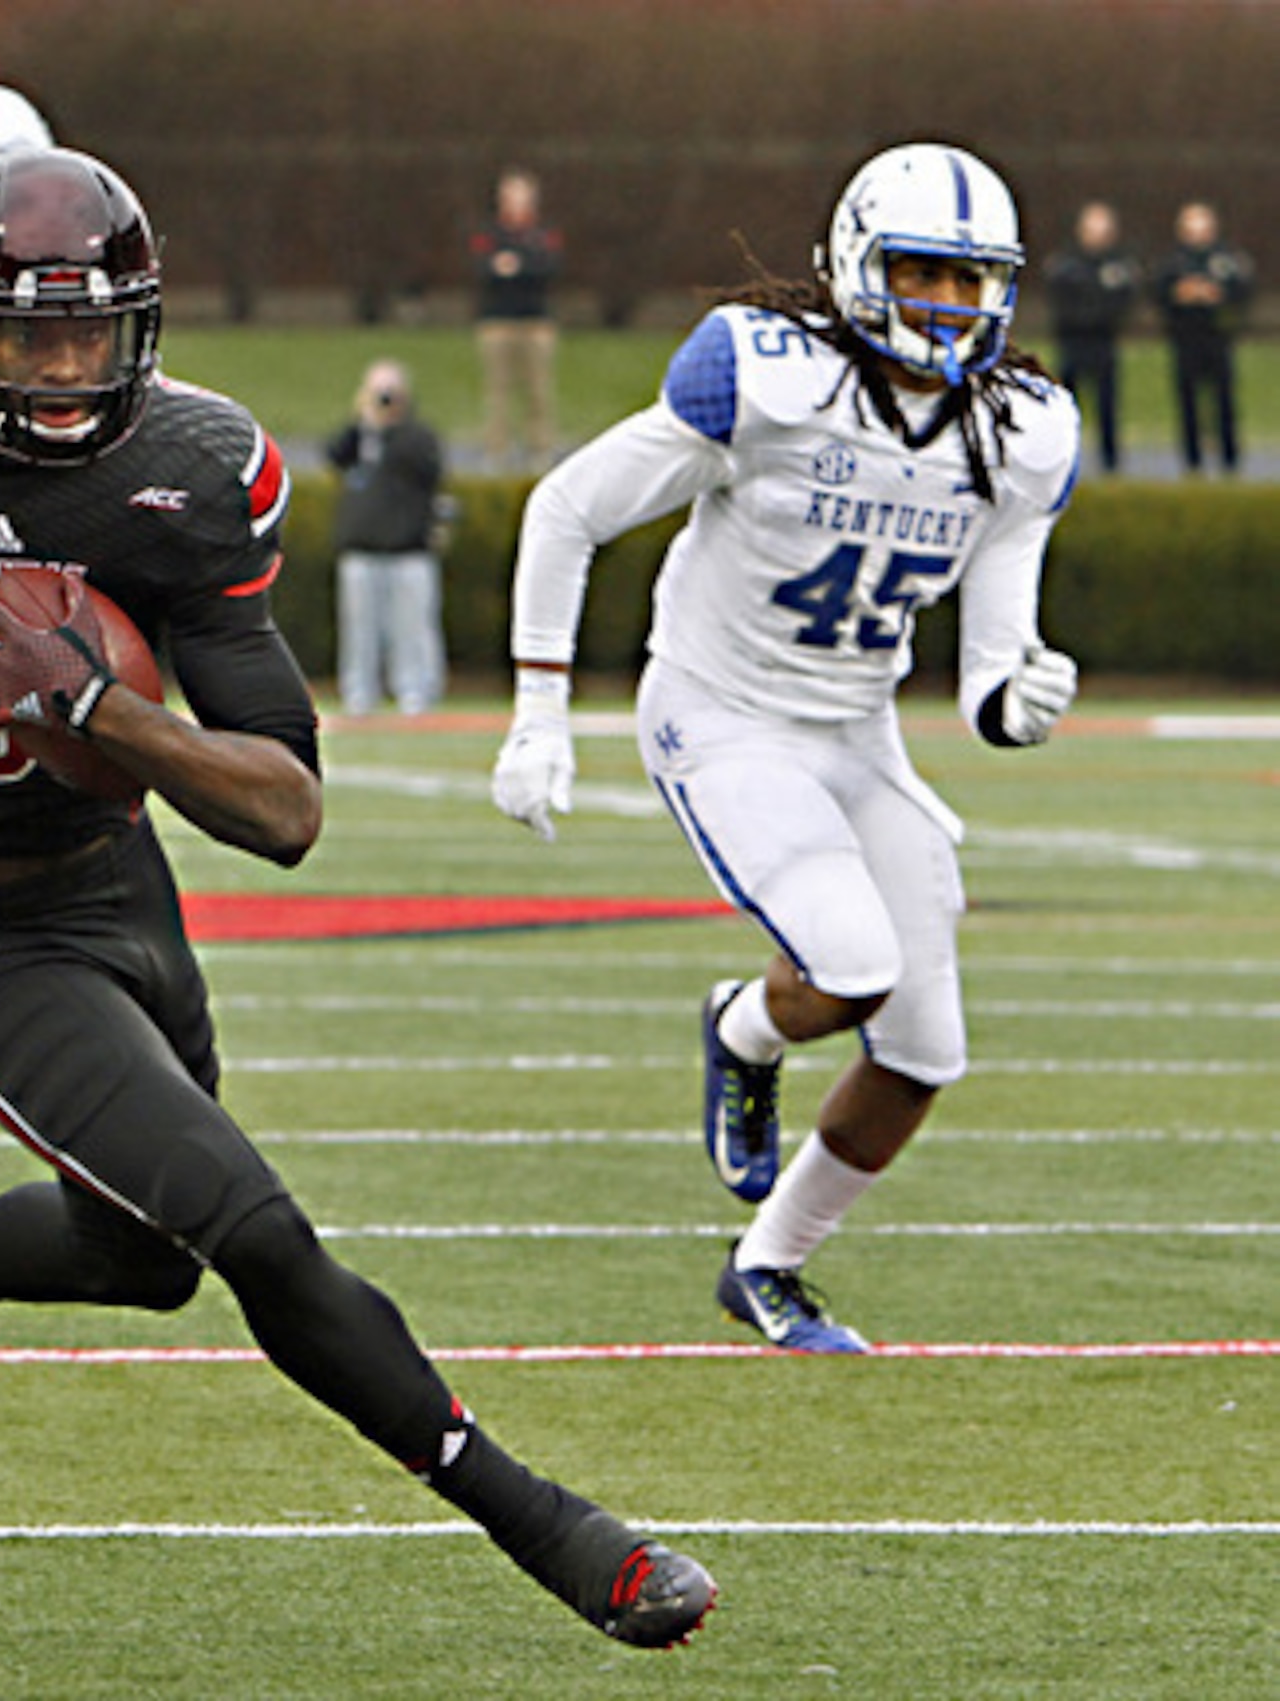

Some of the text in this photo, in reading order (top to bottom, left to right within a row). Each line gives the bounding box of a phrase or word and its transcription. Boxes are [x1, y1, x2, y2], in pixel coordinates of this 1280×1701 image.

[128, 486, 190, 511] ACC
[805, 491, 974, 548] KENTUCKY
[770, 540, 956, 650] 45
